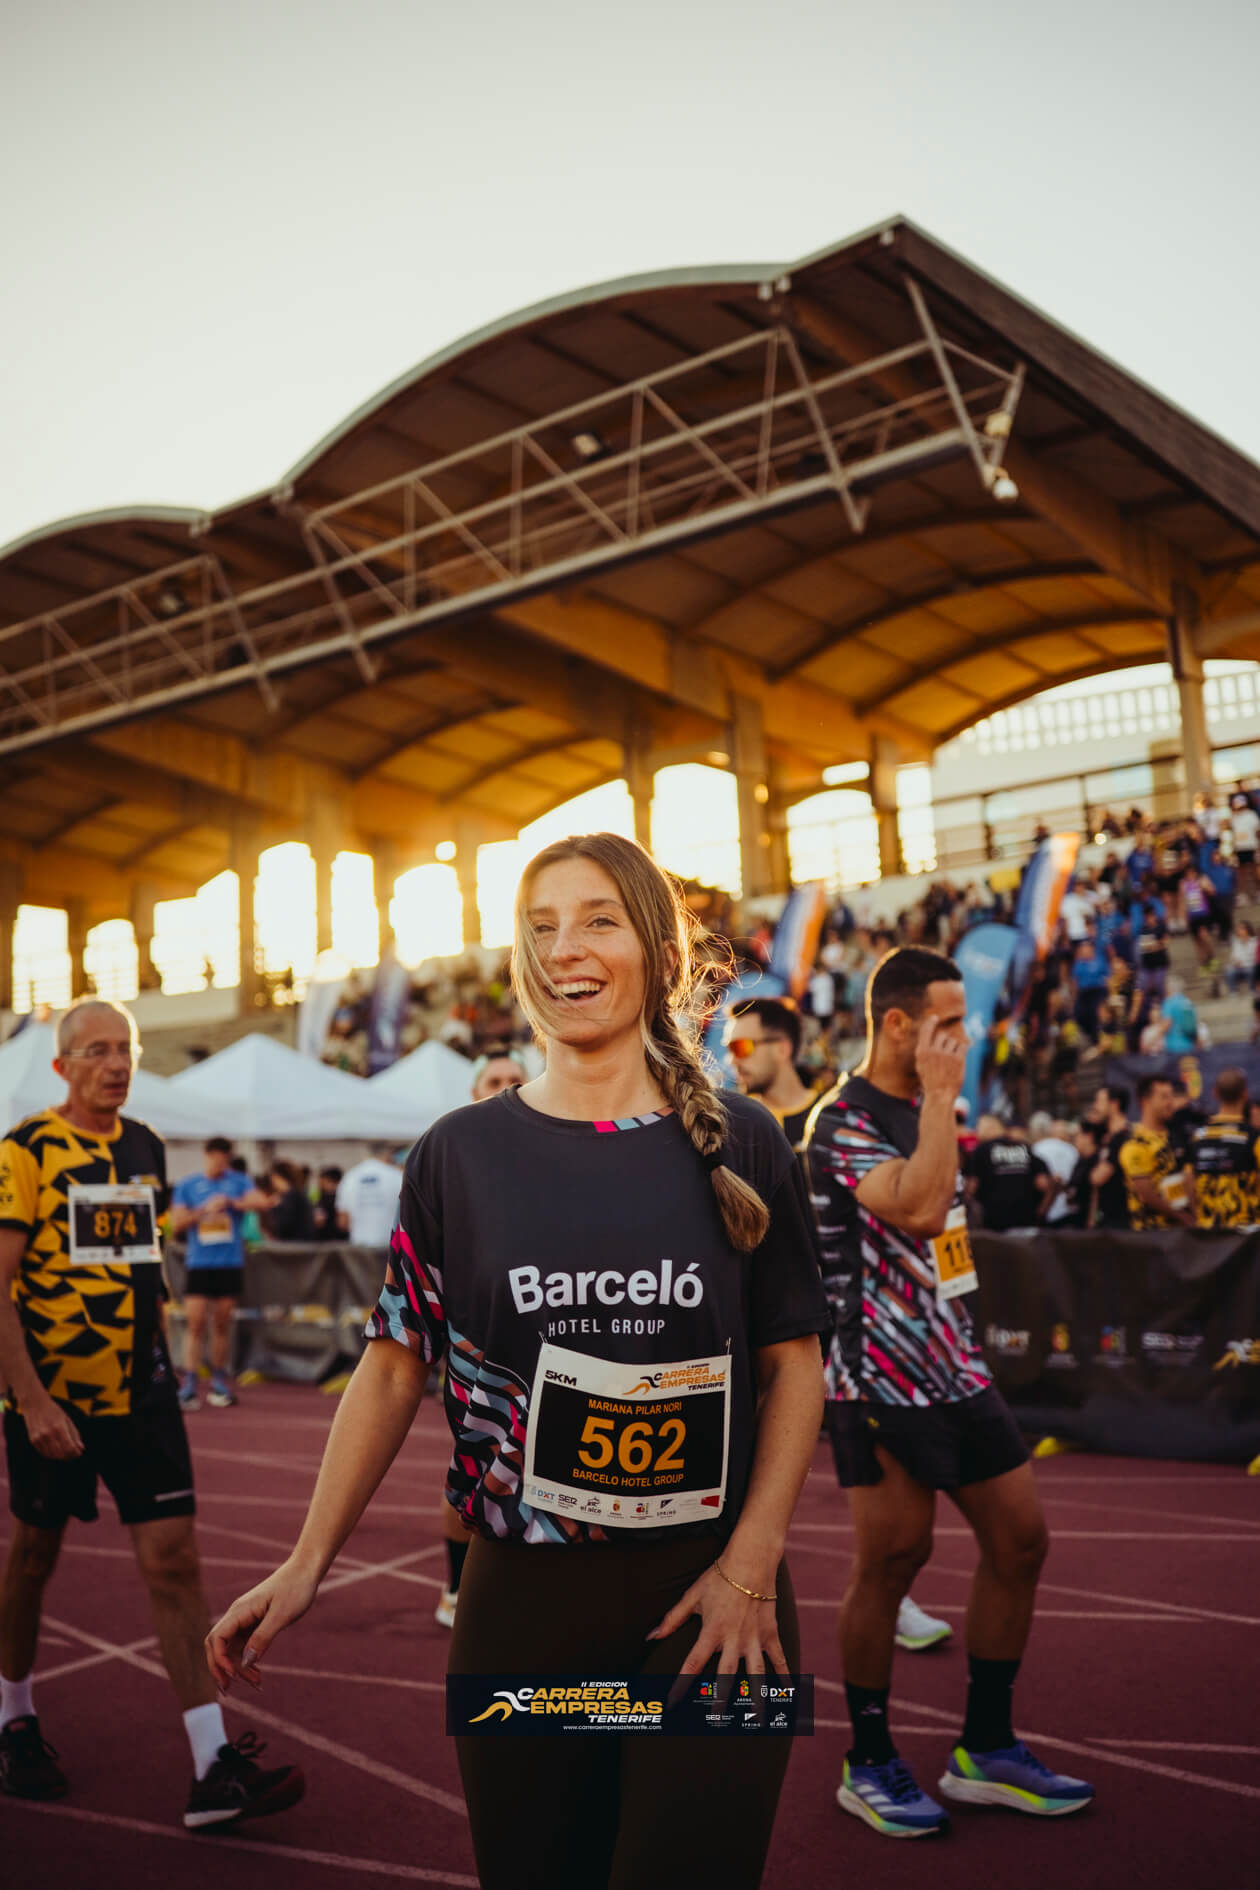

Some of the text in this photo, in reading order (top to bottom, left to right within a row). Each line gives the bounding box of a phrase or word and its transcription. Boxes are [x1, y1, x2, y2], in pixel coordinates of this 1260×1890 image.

[94, 1210, 138, 1239] 874
[508, 1259, 704, 1314] Barceló
[548, 1319, 666, 1337] HOTEL GROUP
[545, 1369, 577, 1386] 5KM
[654, 1367, 710, 1381] CARRERA
[660, 1371, 726, 1389] EMPRESAS
[688, 1381, 725, 1391] TENERIFE
[588, 1399, 682, 1415] MARIANA PILAR NORI
[577, 1415, 687, 1474] 562
[572, 1468, 684, 1487] BARCELO HOTEL GROUP
